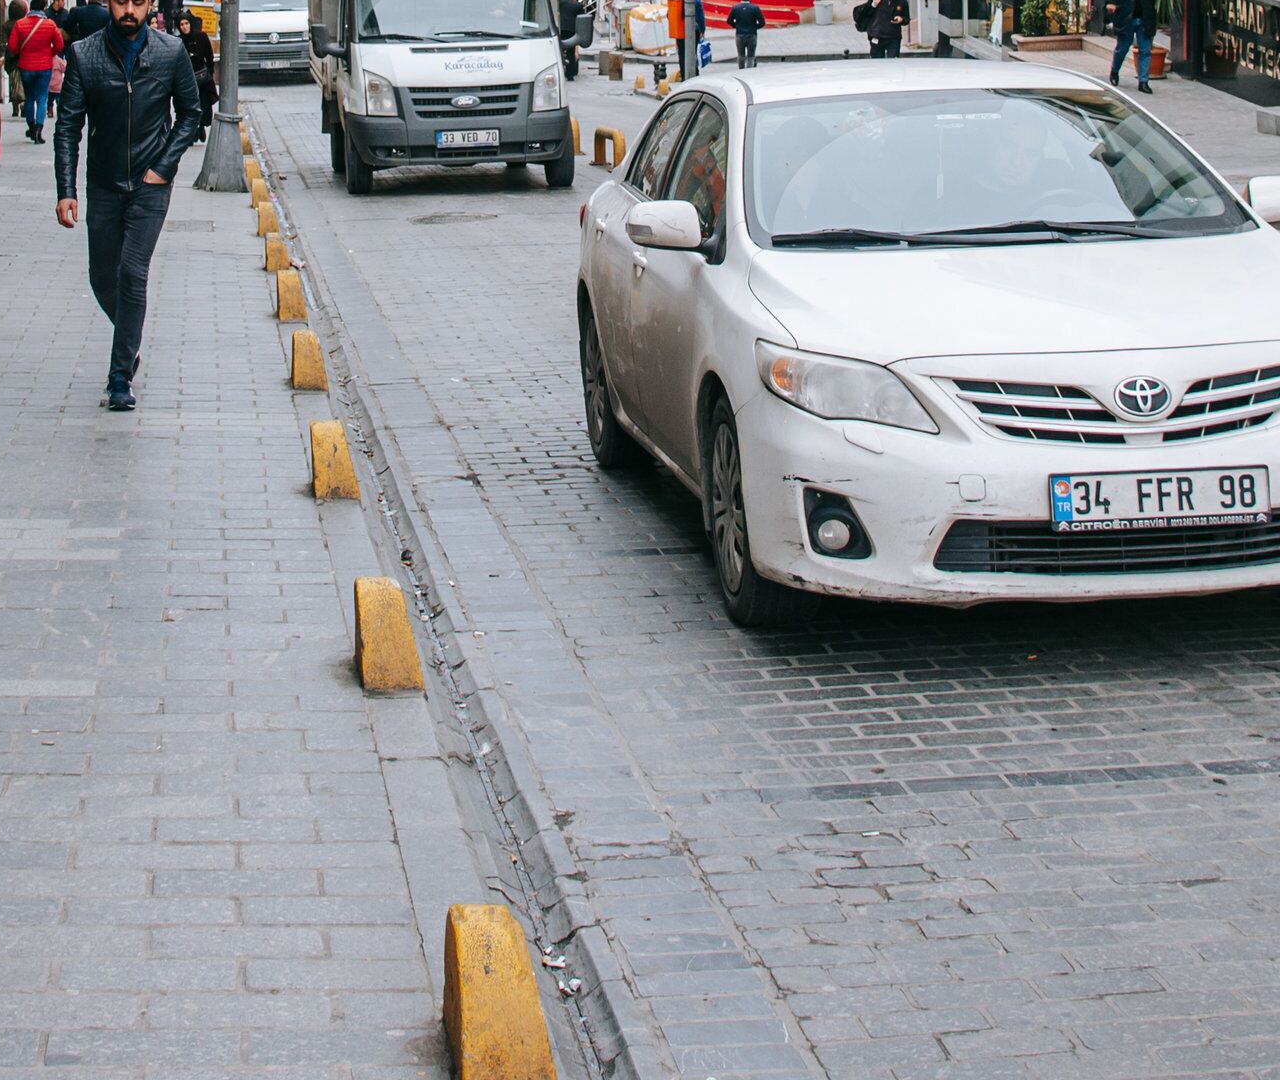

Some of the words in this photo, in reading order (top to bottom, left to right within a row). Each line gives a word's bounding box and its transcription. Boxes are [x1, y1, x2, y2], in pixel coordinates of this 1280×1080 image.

[1215, 29, 1255, 71] STYLE
[442, 130, 454, 144] 33
[461, 129, 479, 143] VED
[485, 129, 498, 142] 70
[1073, 480, 1111, 515] 34
[1136, 476, 1195, 513] FFR
[1219, 474, 1257, 510] 98
[1056, 501, 1071, 513] TR
[1071, 519, 1131, 531] CITROËN
[1131, 517, 1168, 529] SERVİSİ
